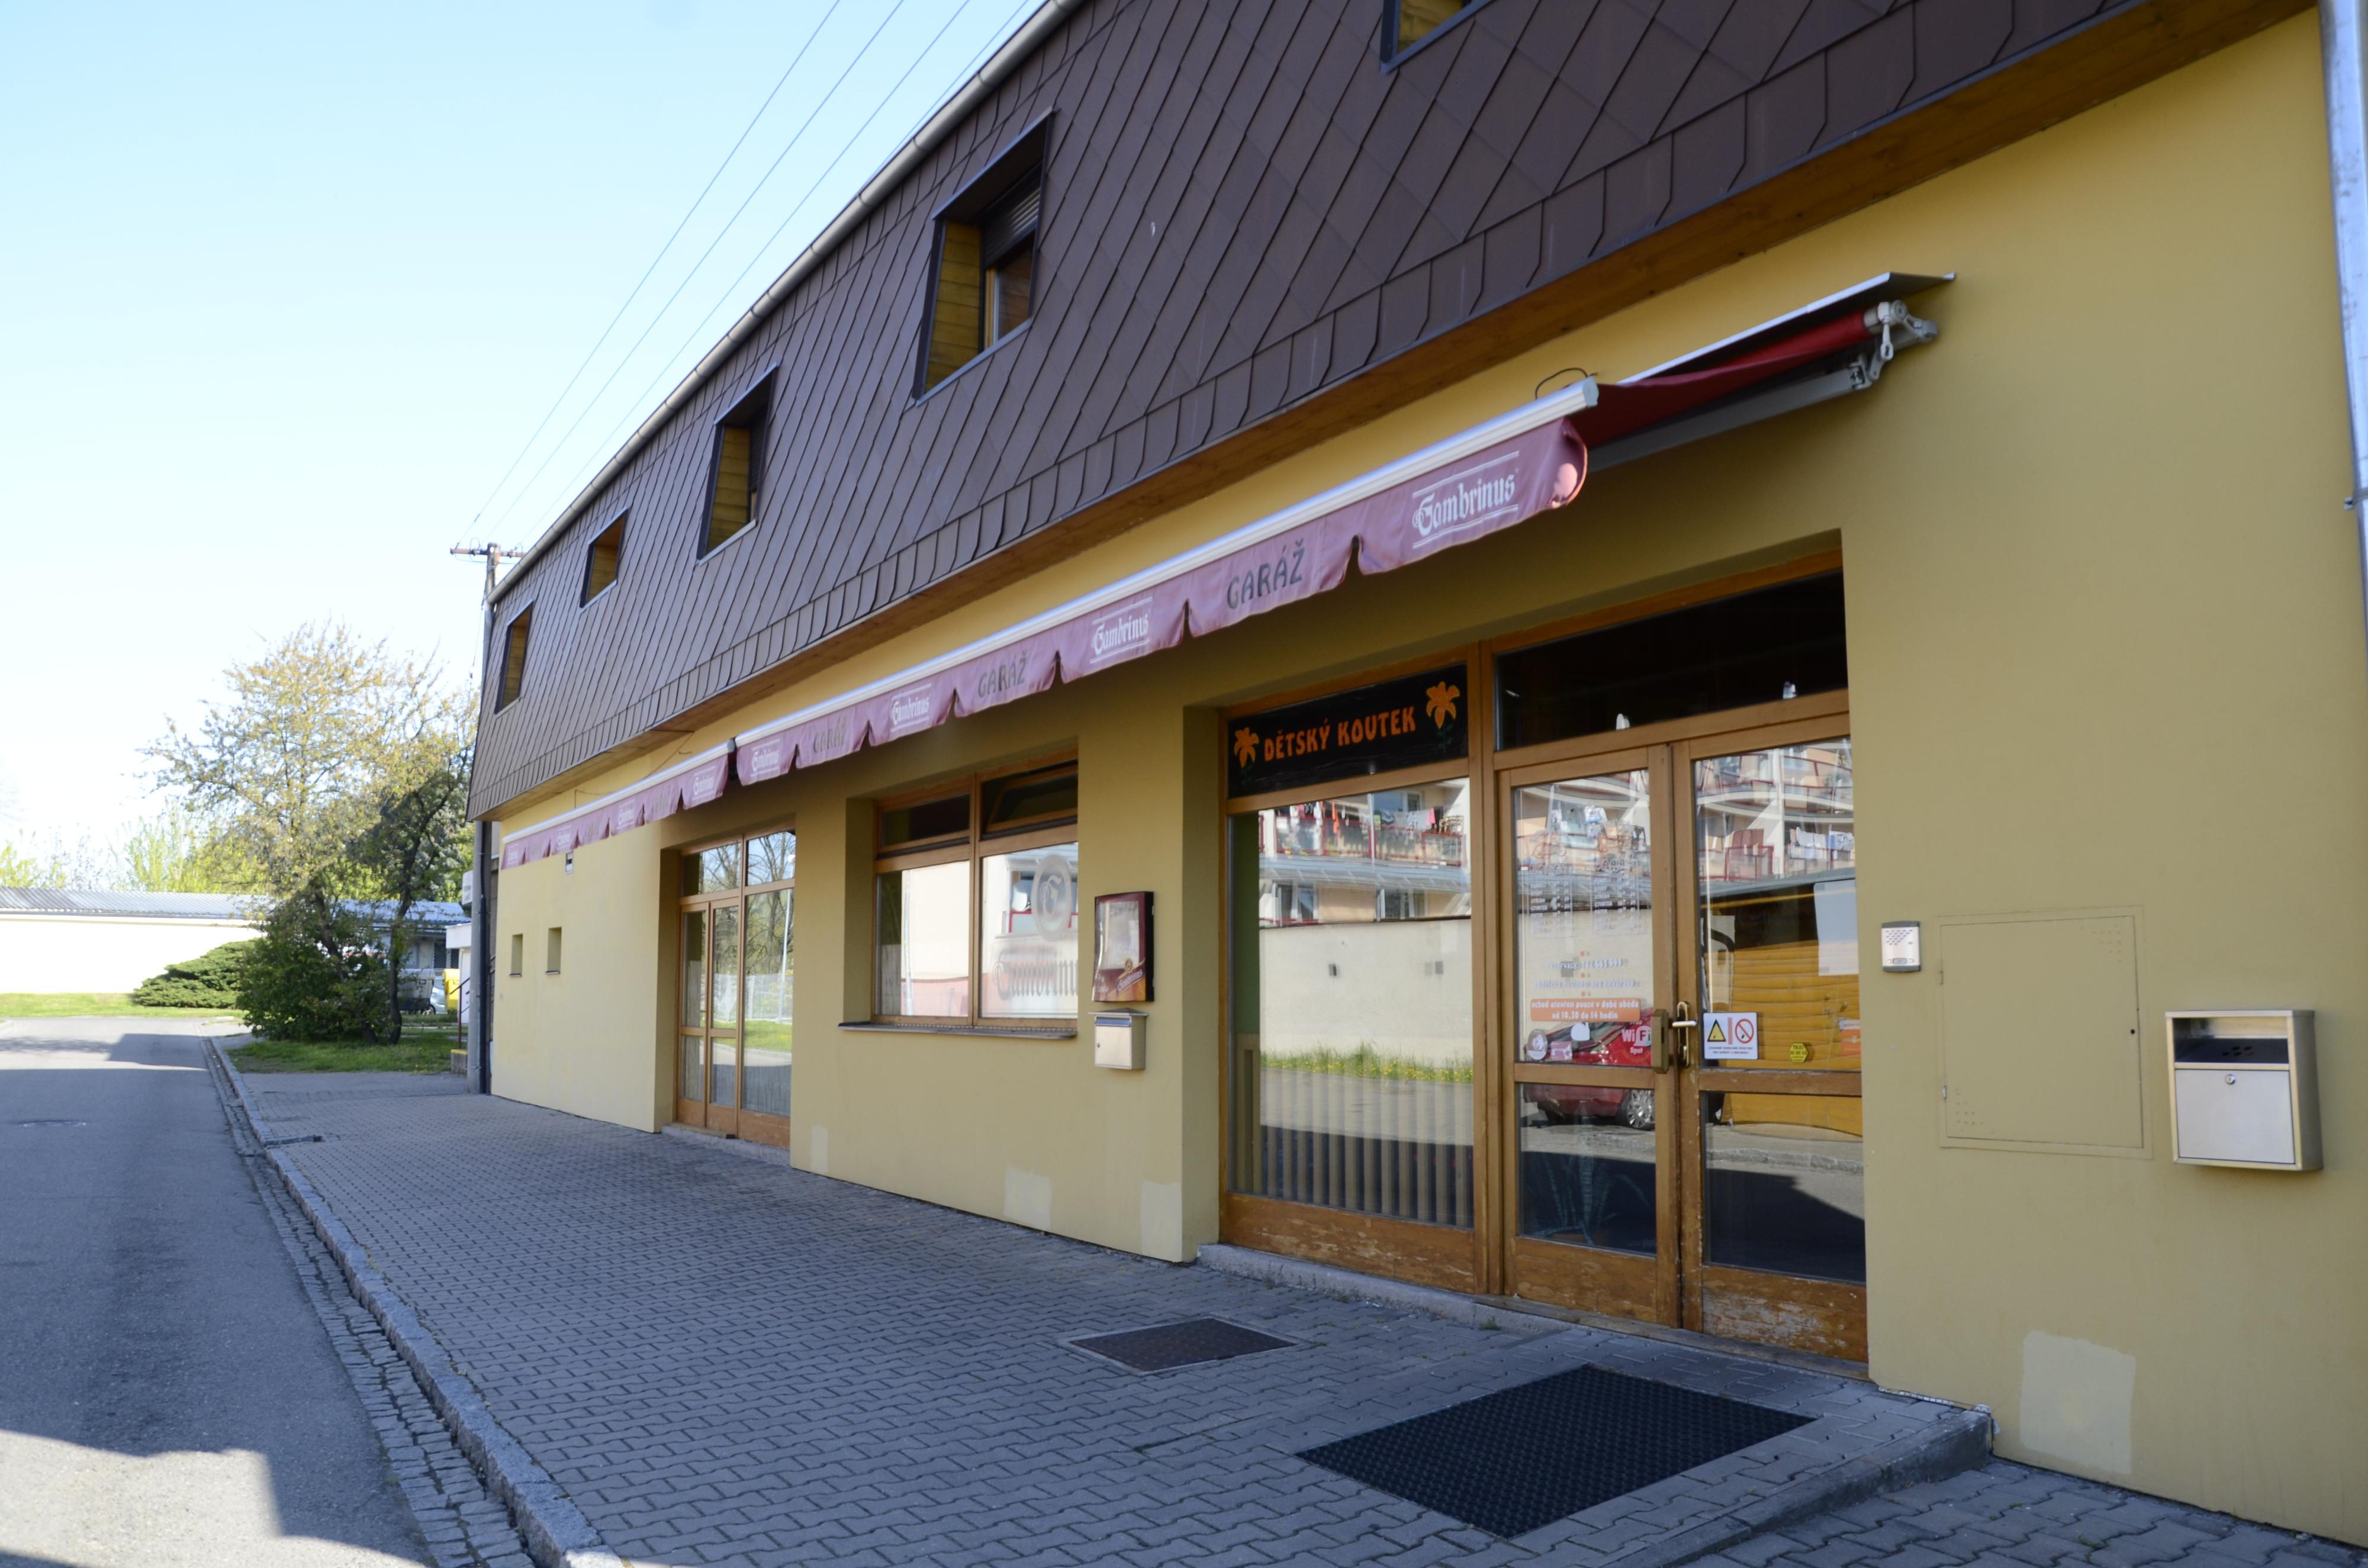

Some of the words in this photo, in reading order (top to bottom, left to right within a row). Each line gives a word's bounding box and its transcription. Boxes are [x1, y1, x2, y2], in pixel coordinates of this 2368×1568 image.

[1413, 474, 1515, 536] Gambrinus
[1227, 539, 1305, 609] GARÁŽ
[1092, 613, 1150, 655] Gambrinus
[979, 651, 1028, 697] GARÁŽ
[890, 696, 929, 725] Gambrinus
[1264, 717, 1331, 762] DĚTSKÝ
[1337, 706, 1416, 746] KOUTEK
